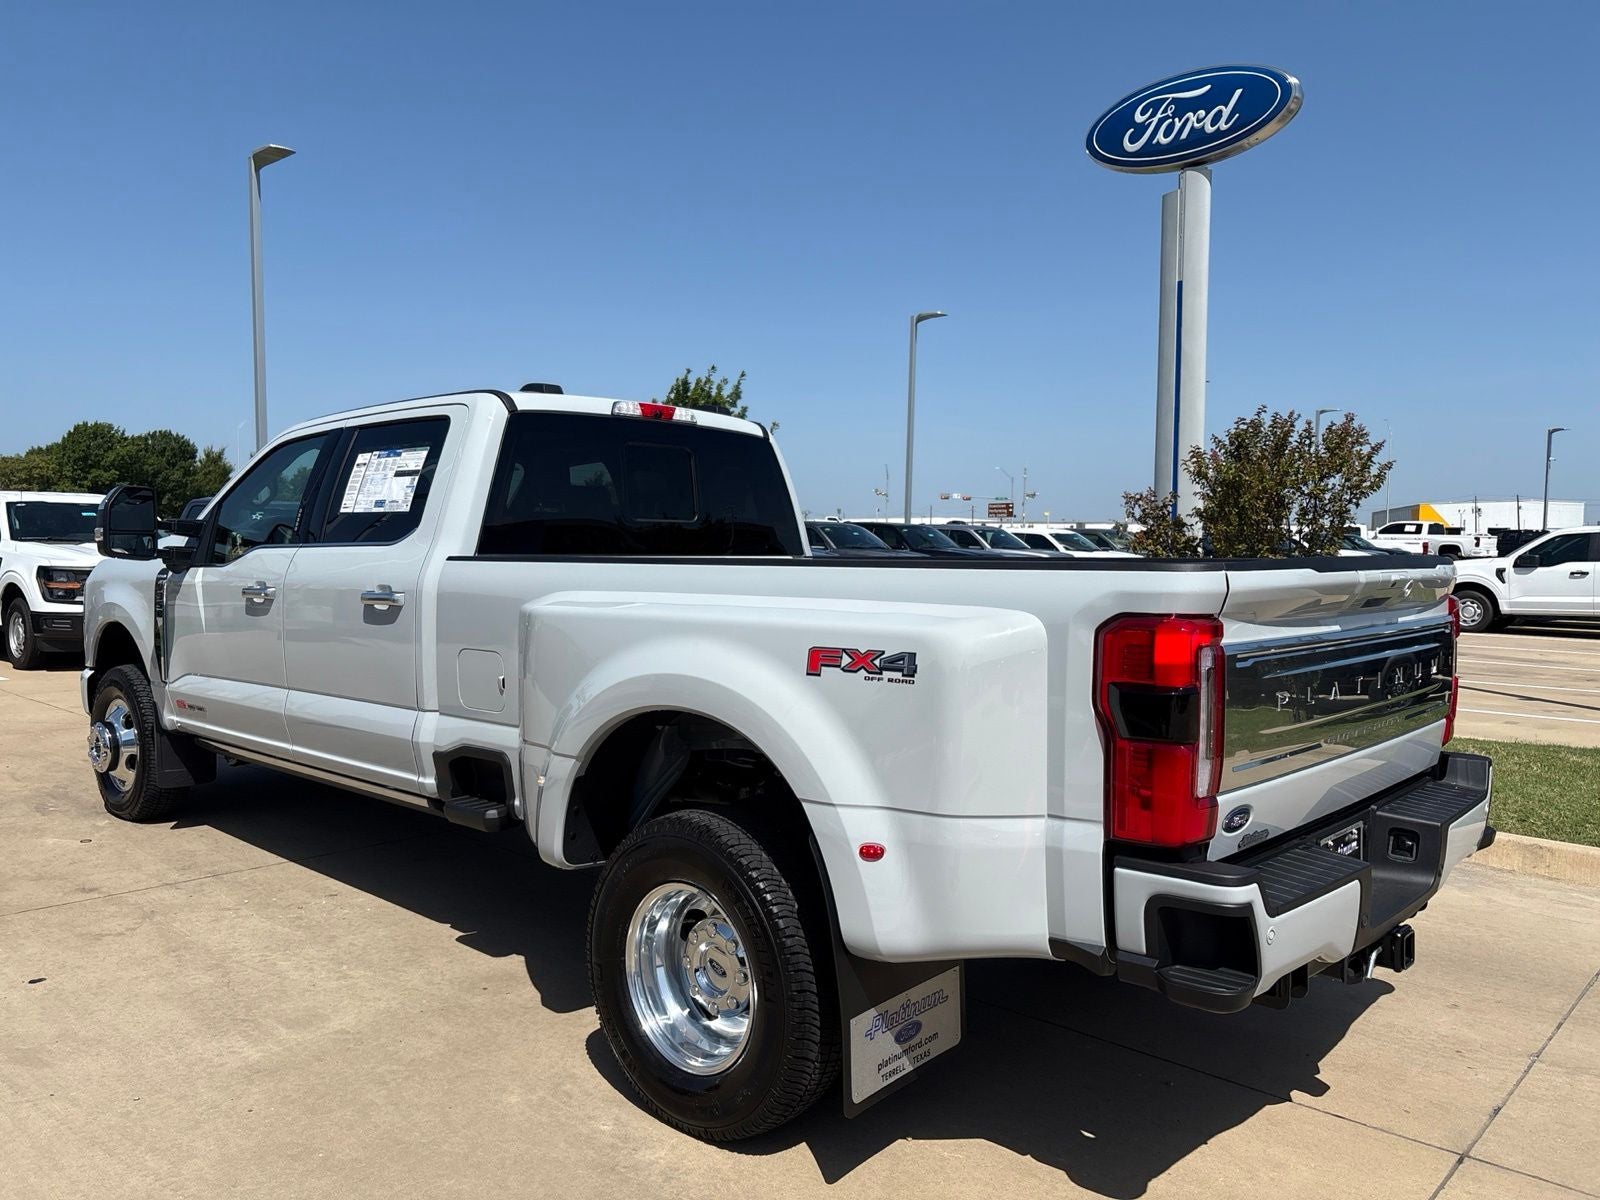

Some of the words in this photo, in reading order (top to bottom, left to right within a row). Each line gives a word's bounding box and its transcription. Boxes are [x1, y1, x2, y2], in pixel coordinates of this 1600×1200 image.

[1122, 84, 1244, 153] Ford
[806, 646, 917, 678] FX4
[887, 677, 915, 685] ROAD
[864, 988, 949, 1041] Platinum
[877, 1031, 939, 1074] platinumford.com
[881, 1064, 906, 1083] TERRELL
[912, 1048, 931, 1065] TEXAS
